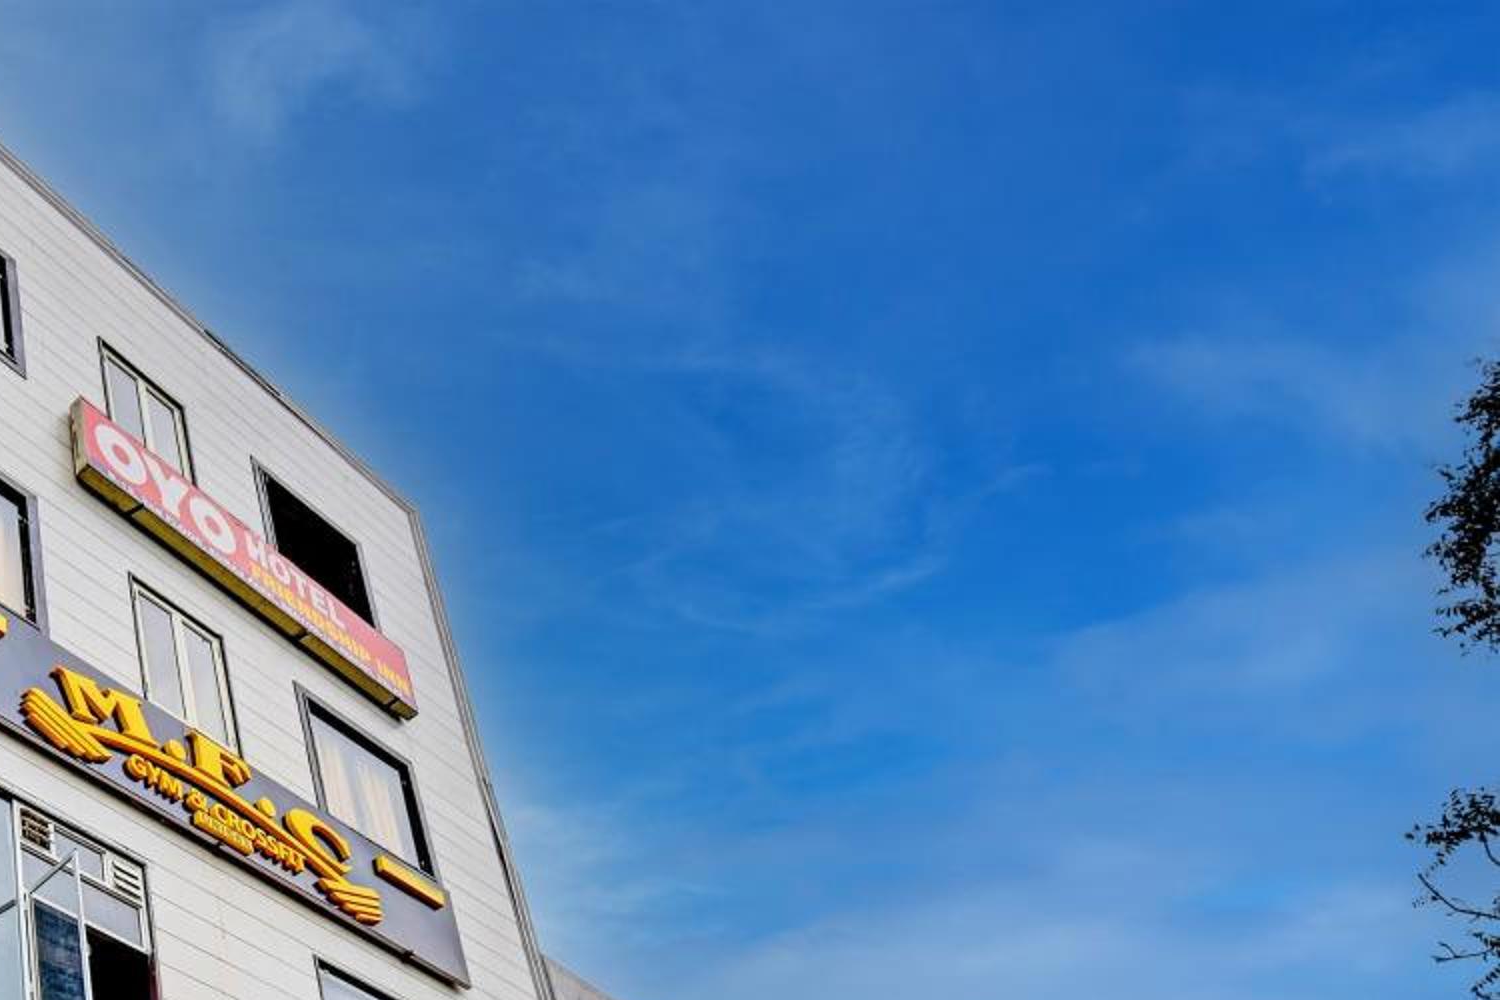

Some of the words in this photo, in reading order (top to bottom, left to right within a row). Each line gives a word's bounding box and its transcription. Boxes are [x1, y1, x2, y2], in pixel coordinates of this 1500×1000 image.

[94, 424, 236, 555] OYO
[243, 525, 347, 629] HOTEL
[126, 754, 183, 802] GYM
[183, 788, 208, 812] &
[208, 802, 307, 874] CROSSFIT
